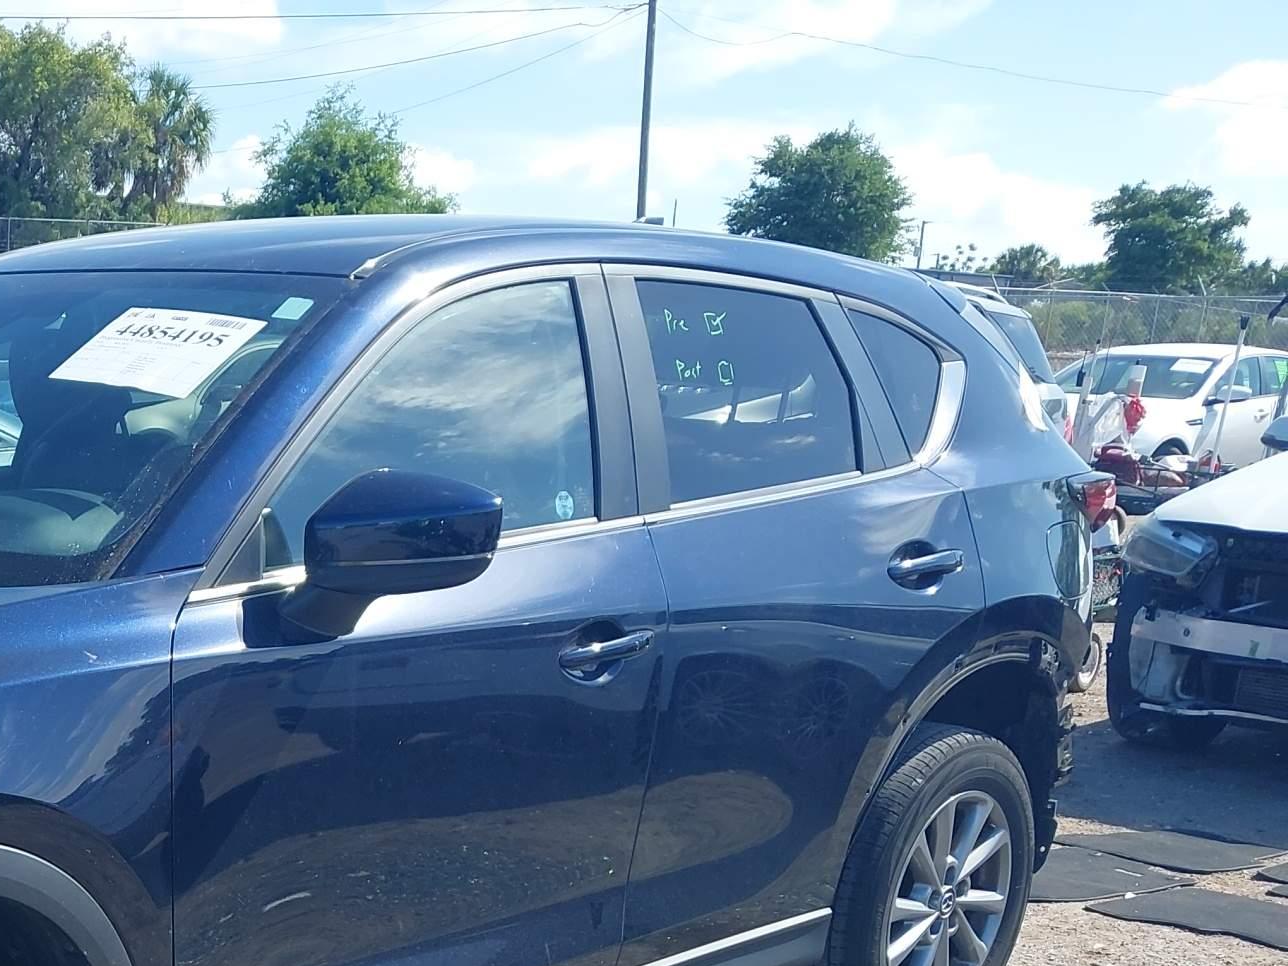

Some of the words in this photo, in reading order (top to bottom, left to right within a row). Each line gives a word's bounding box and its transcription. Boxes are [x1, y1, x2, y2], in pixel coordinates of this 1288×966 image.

[663, 308, 689, 335] Pre
[116, 323, 230, 348] 44854195
[675, 359, 702, 381] Post
